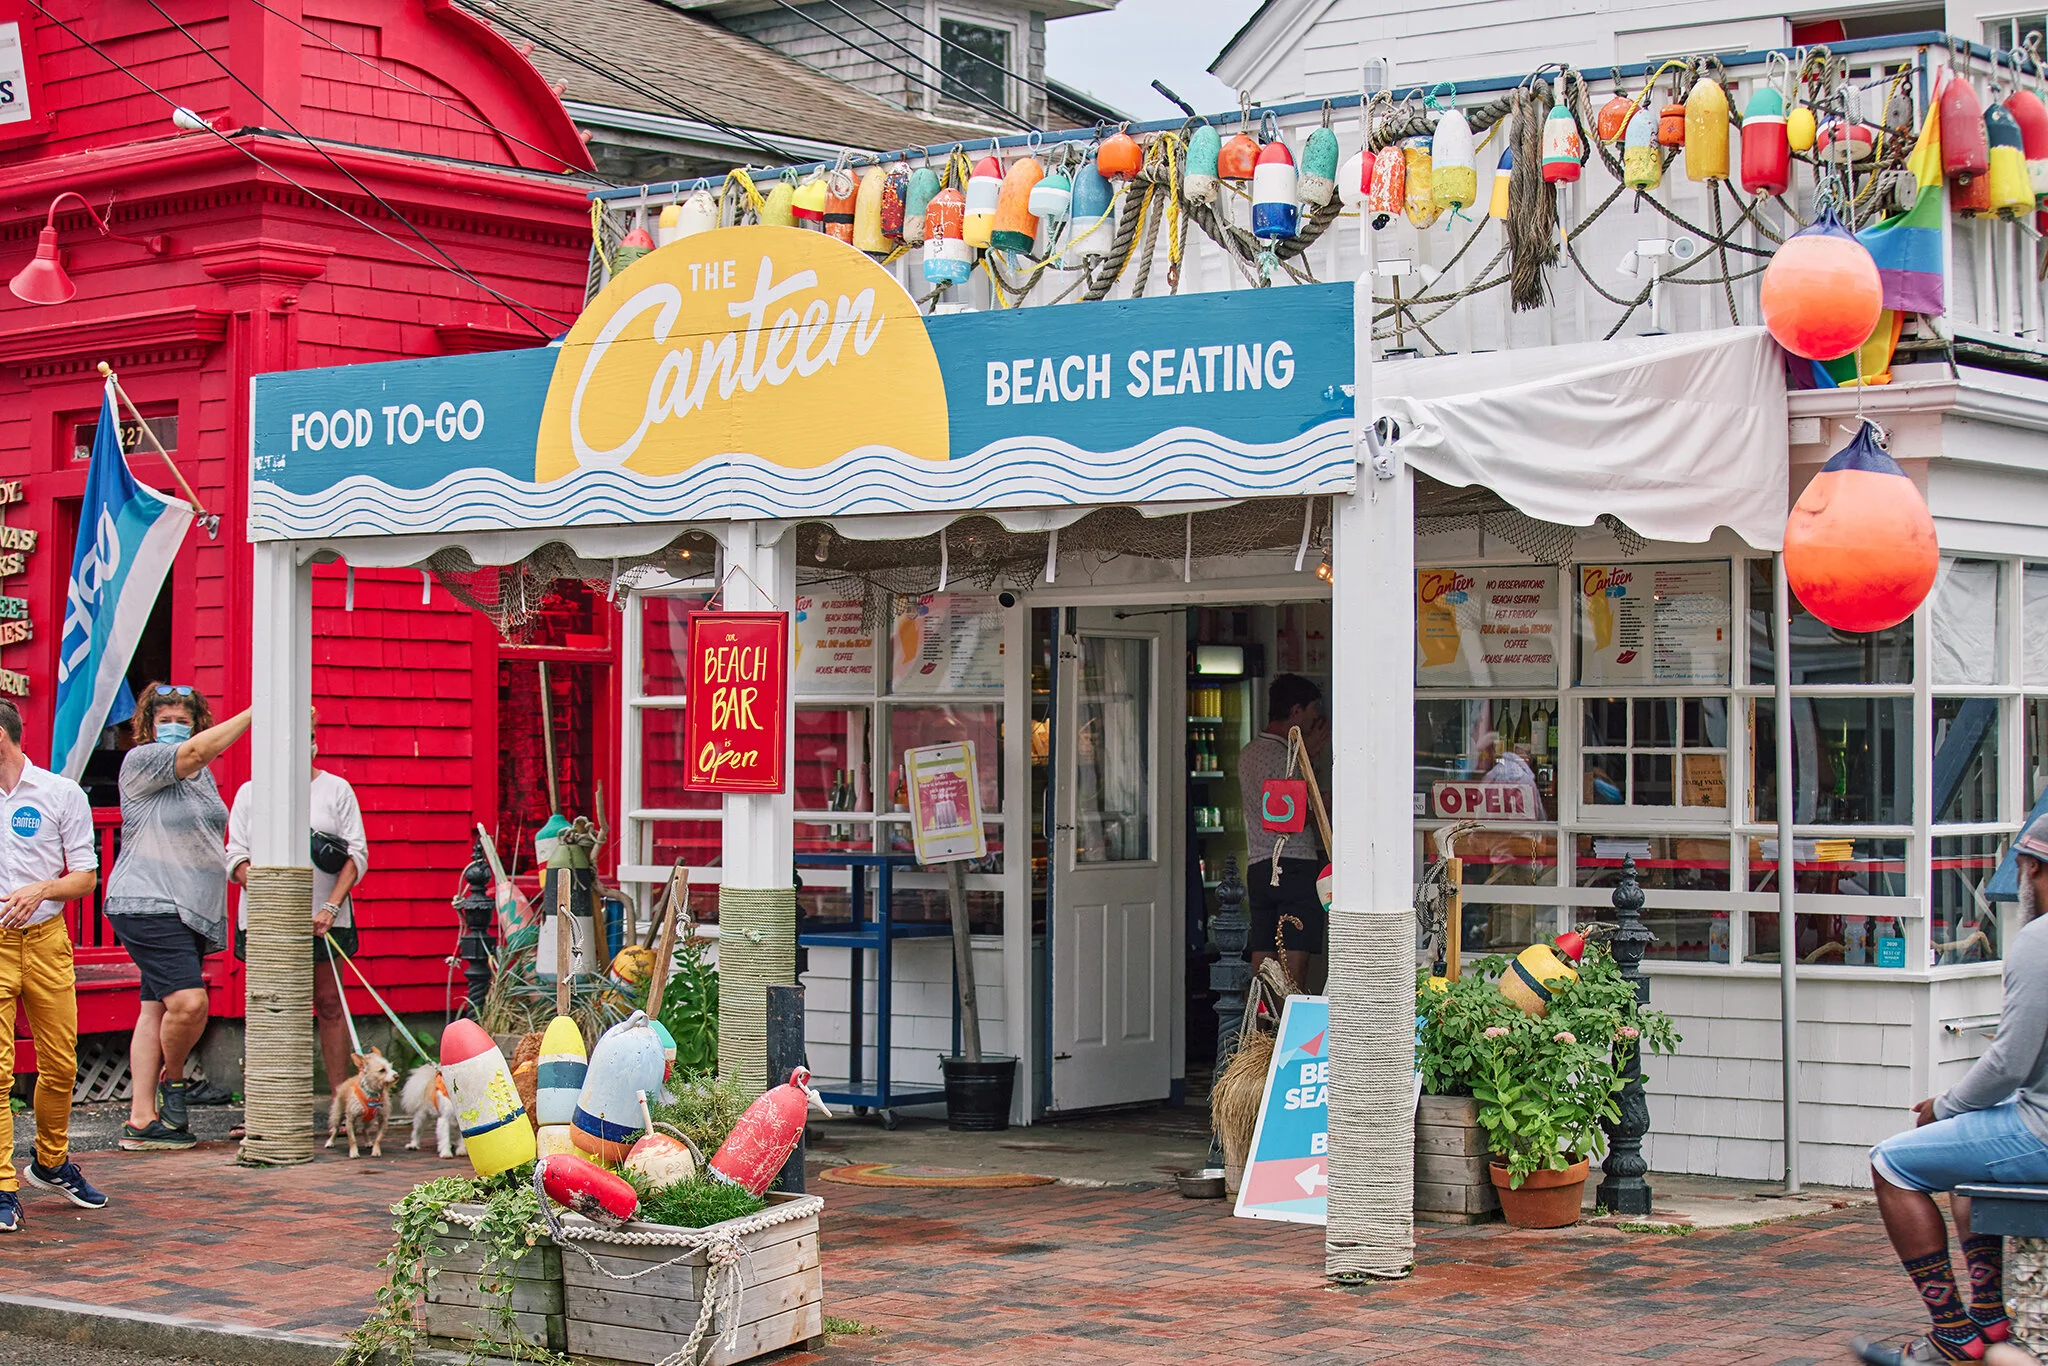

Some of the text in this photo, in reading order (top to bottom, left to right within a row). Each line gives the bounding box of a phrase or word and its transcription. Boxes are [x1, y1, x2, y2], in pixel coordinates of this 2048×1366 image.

[688, 259, 736, 292] THE
[570, 255, 884, 467] Canteen
[986, 340, 1295, 406] BEACH SEATING
[291, 399, 485, 452] FOOD TO-GO
[1421, 571, 1475, 604] Canteen
[1485, 579, 1546, 589] NO RESERVATIONS
[1583, 567, 1634, 597] Canteen
[1491, 594, 1541, 604] BEACH SEATING
[1494, 609, 1538, 619] PET FRIENDLY
[833, 652, 854, 661] COFFEE
[1503, 639, 1529, 649] COFFEE
[704, 645, 767, 685] BEACH
[1480, 653, 1553, 664] HOUSE MADE PASTRIES
[0, 669, 26, 696] RN
[711, 686, 764, 731] BAR
[724, 738, 732, 748] is
[699, 740, 759, 784] Open
[1440, 787, 1525, 814] OPEN
